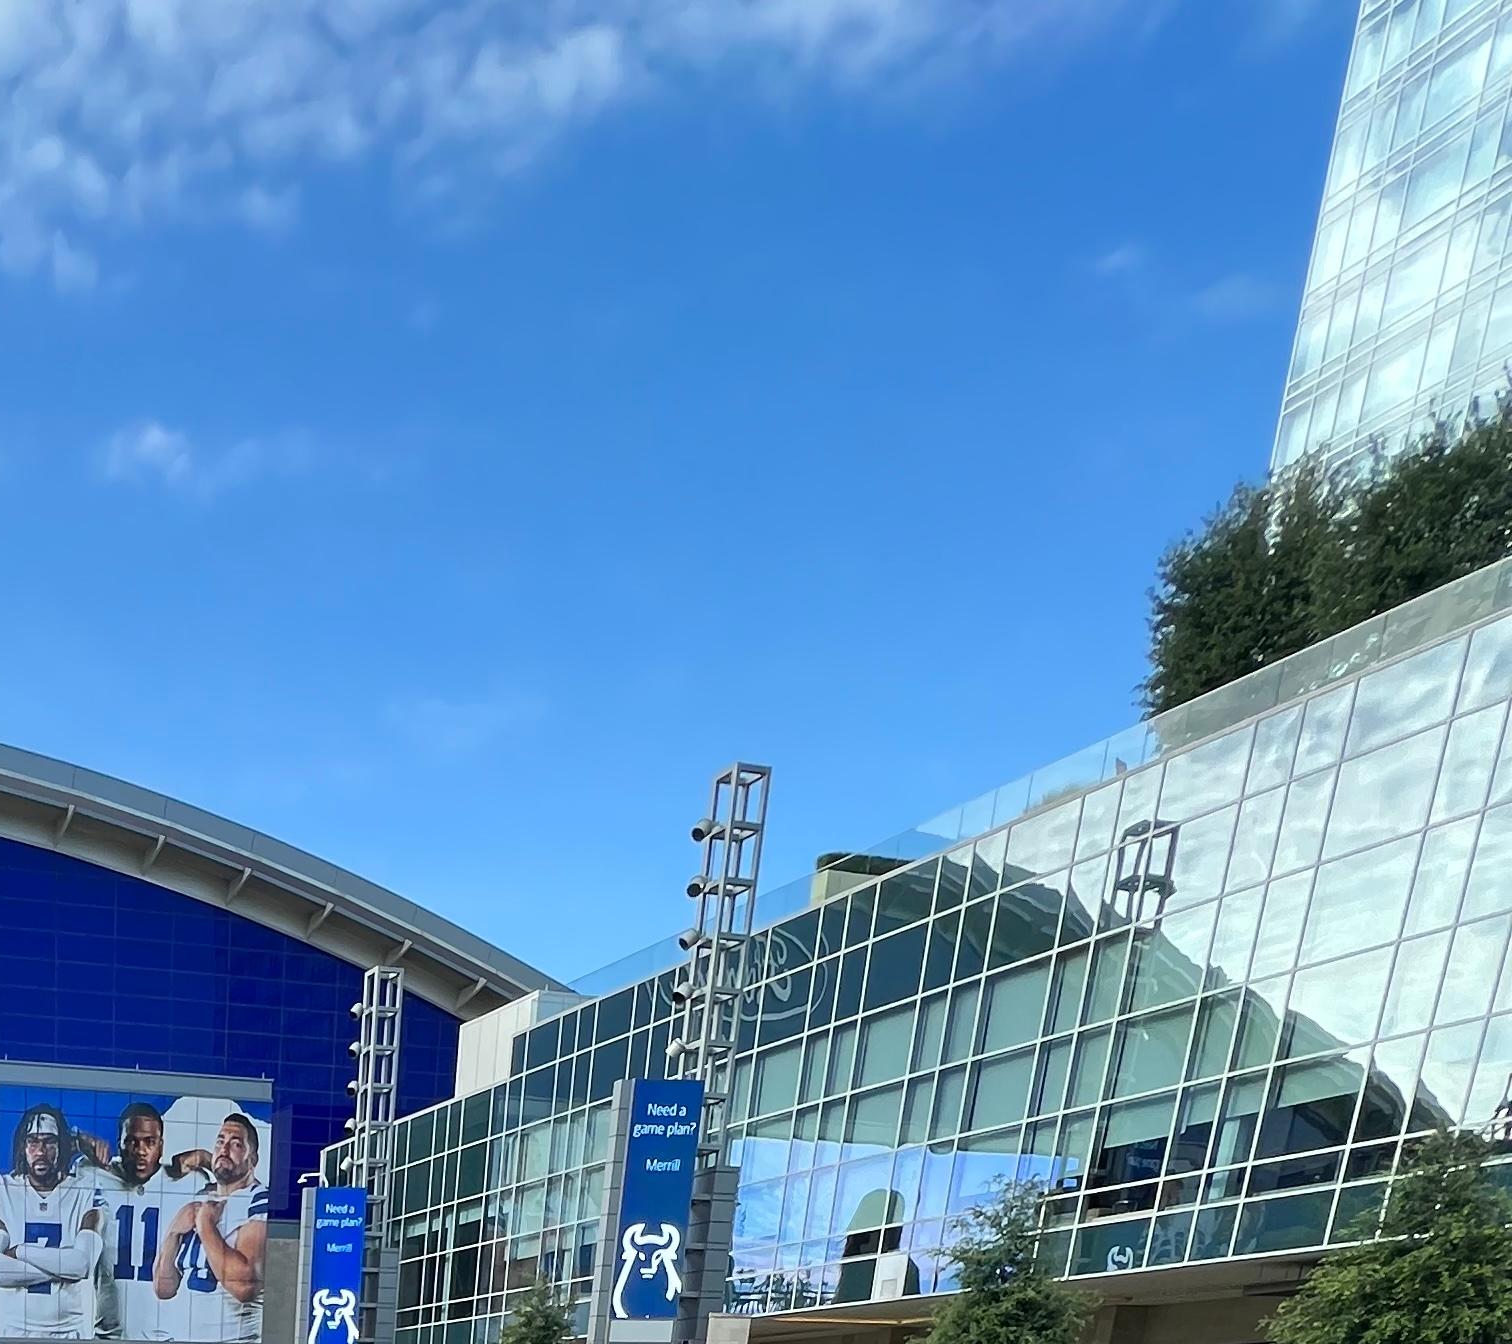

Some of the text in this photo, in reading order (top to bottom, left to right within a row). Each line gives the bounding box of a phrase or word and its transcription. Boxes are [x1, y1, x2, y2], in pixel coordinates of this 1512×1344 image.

[647, 1103, 687, 1117] Need a
[632, 1121, 697, 1138] game plan?
[645, 1159, 681, 1172] Merrill
[325, 1203, 355, 1214] Need a
[316, 1217, 363, 1229] game plan?
[114, 1204, 160, 1281] 11
